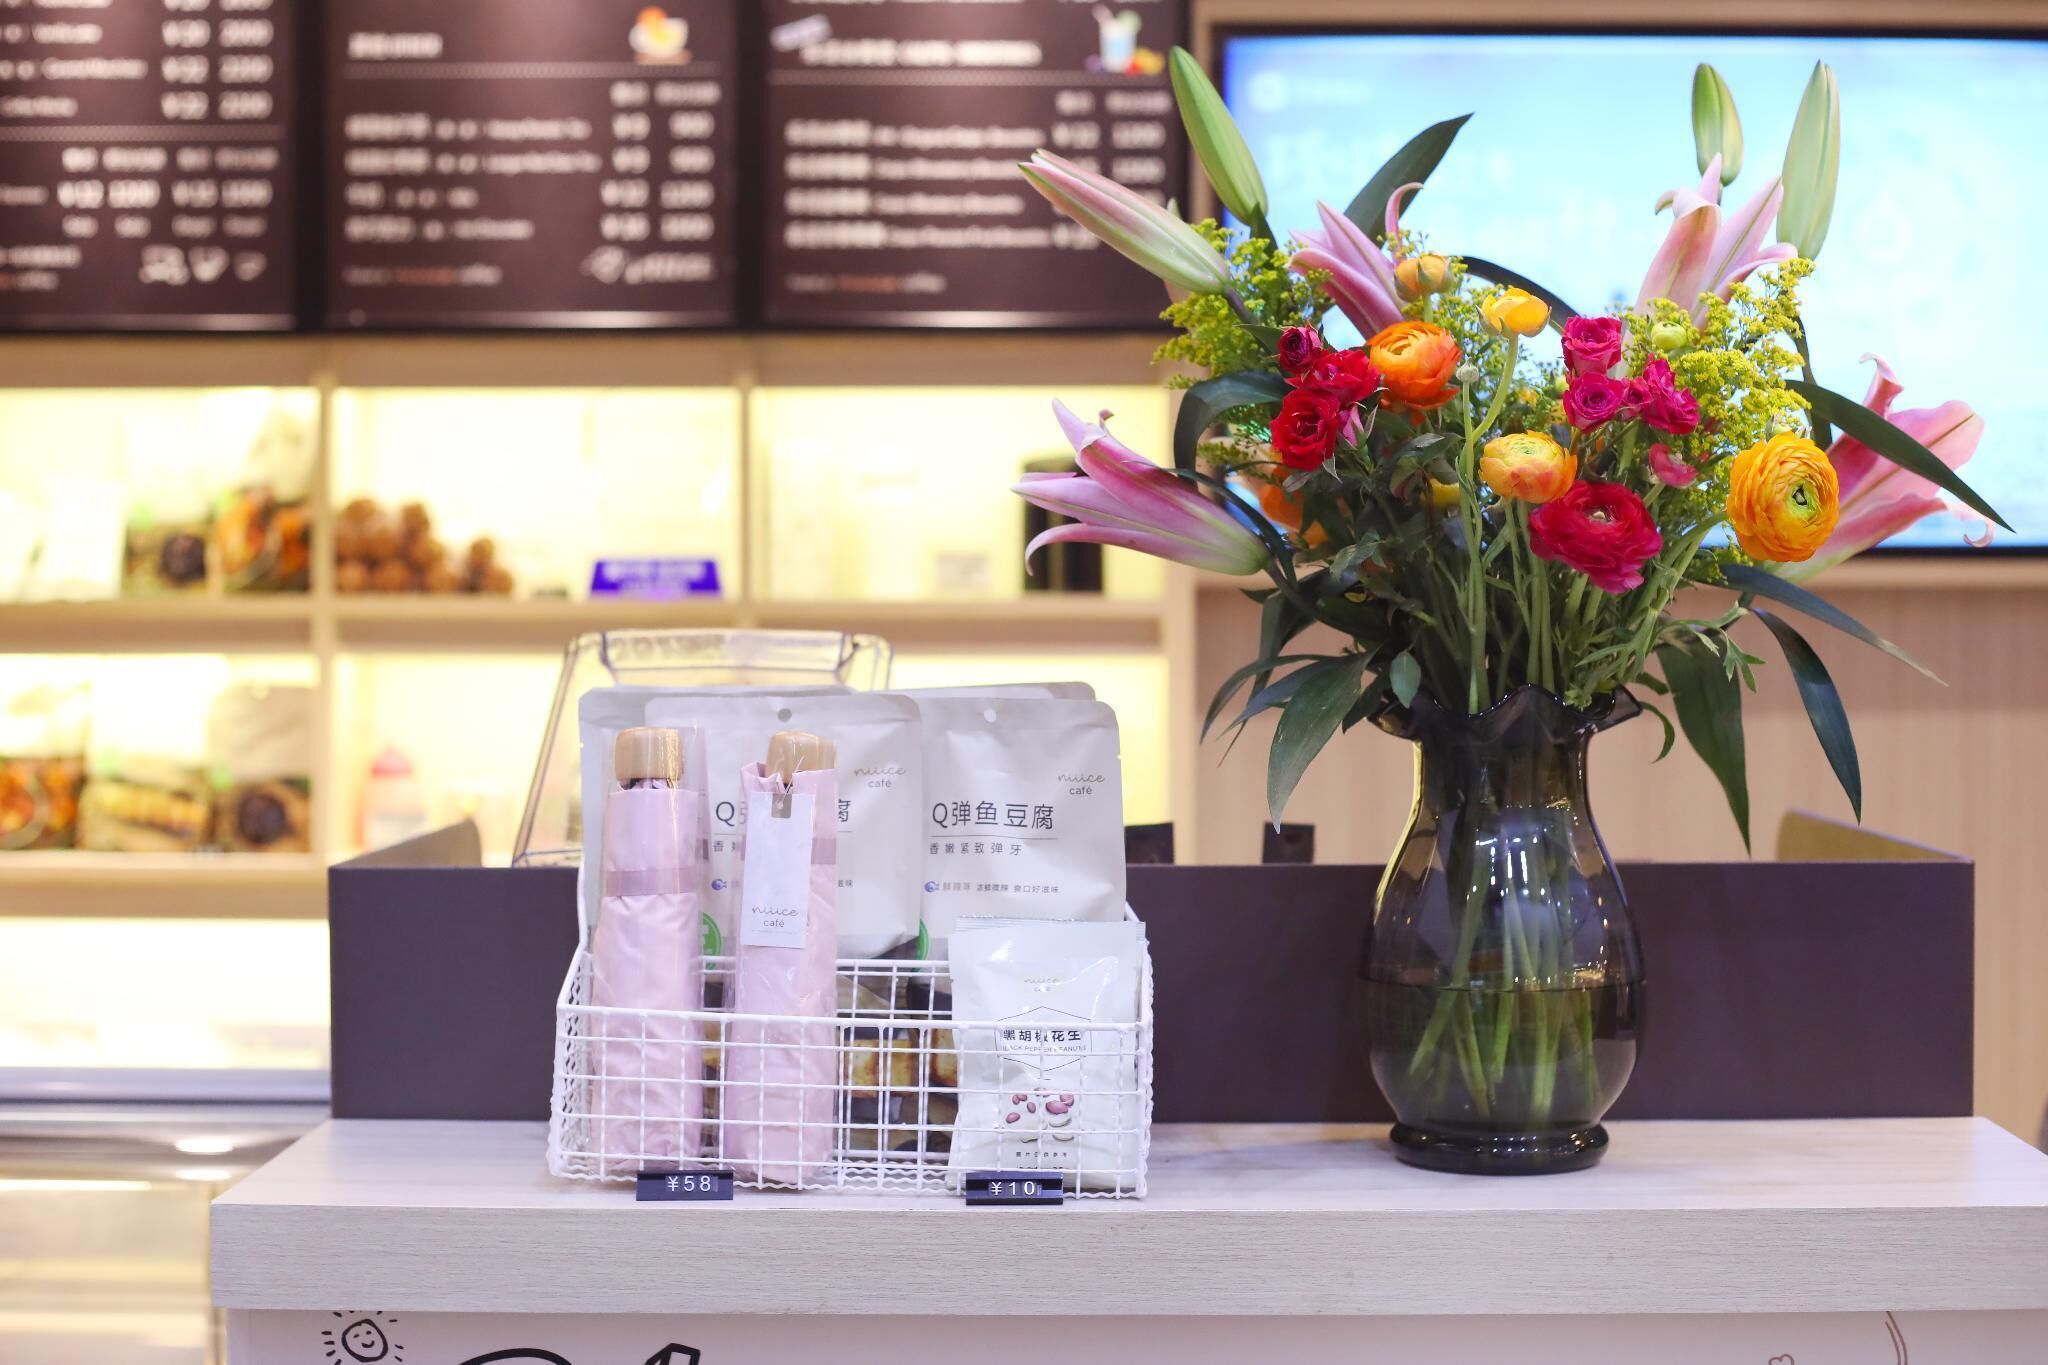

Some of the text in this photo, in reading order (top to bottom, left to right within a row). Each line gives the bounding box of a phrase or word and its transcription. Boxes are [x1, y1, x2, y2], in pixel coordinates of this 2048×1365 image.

[868, 778, 892, 788] café
[1069, 786, 1093, 795] café
[932, 800, 1054, 830] Q弹鱼豆腐
[763, 918, 785, 928] café
[667, 1175, 711, 1192] ¥58
[991, 1181, 1035, 1196] ¥10
